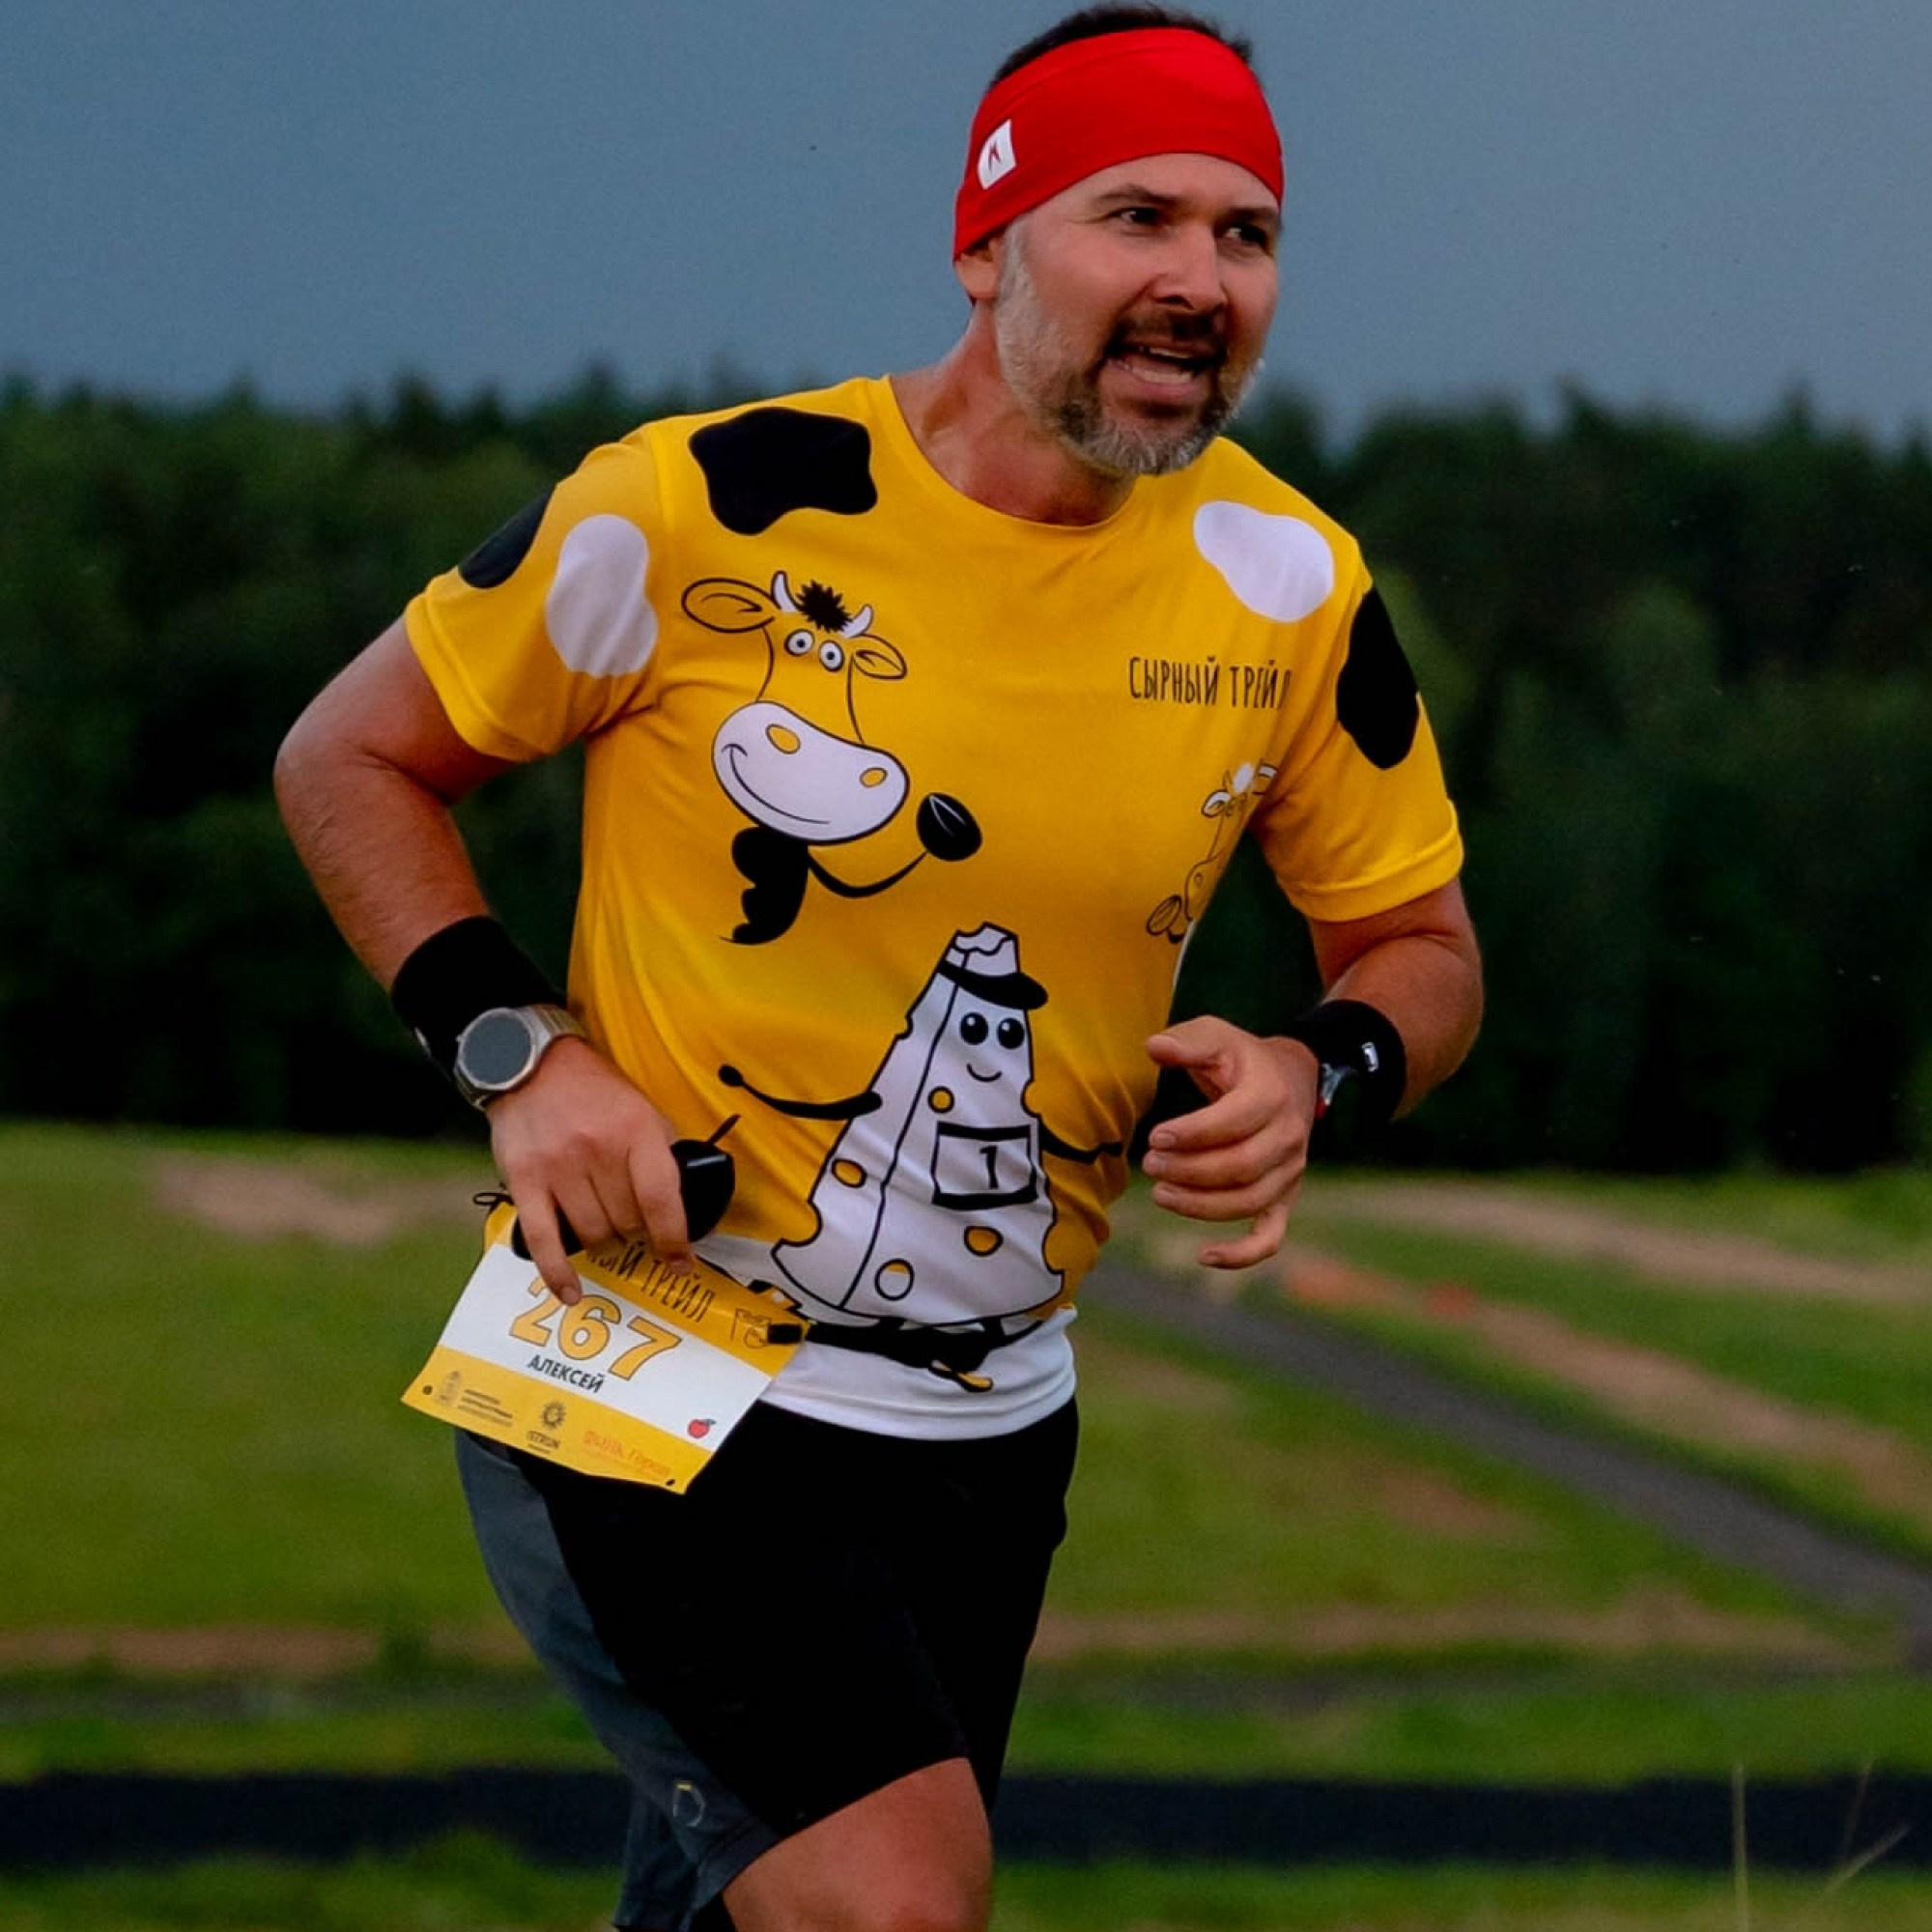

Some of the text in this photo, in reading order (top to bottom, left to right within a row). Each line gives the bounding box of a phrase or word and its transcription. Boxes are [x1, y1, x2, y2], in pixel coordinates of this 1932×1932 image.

[1128, 655, 1221, 706] СЫРНЫЙ
[979, 1145, 1000, 1190] 1
[639, 1258, 716, 1323] ТРЕЙЛ
[508, 1275, 683, 1381] 267
[526, 1354, 607, 1394] АЛЕКСЕЙ
